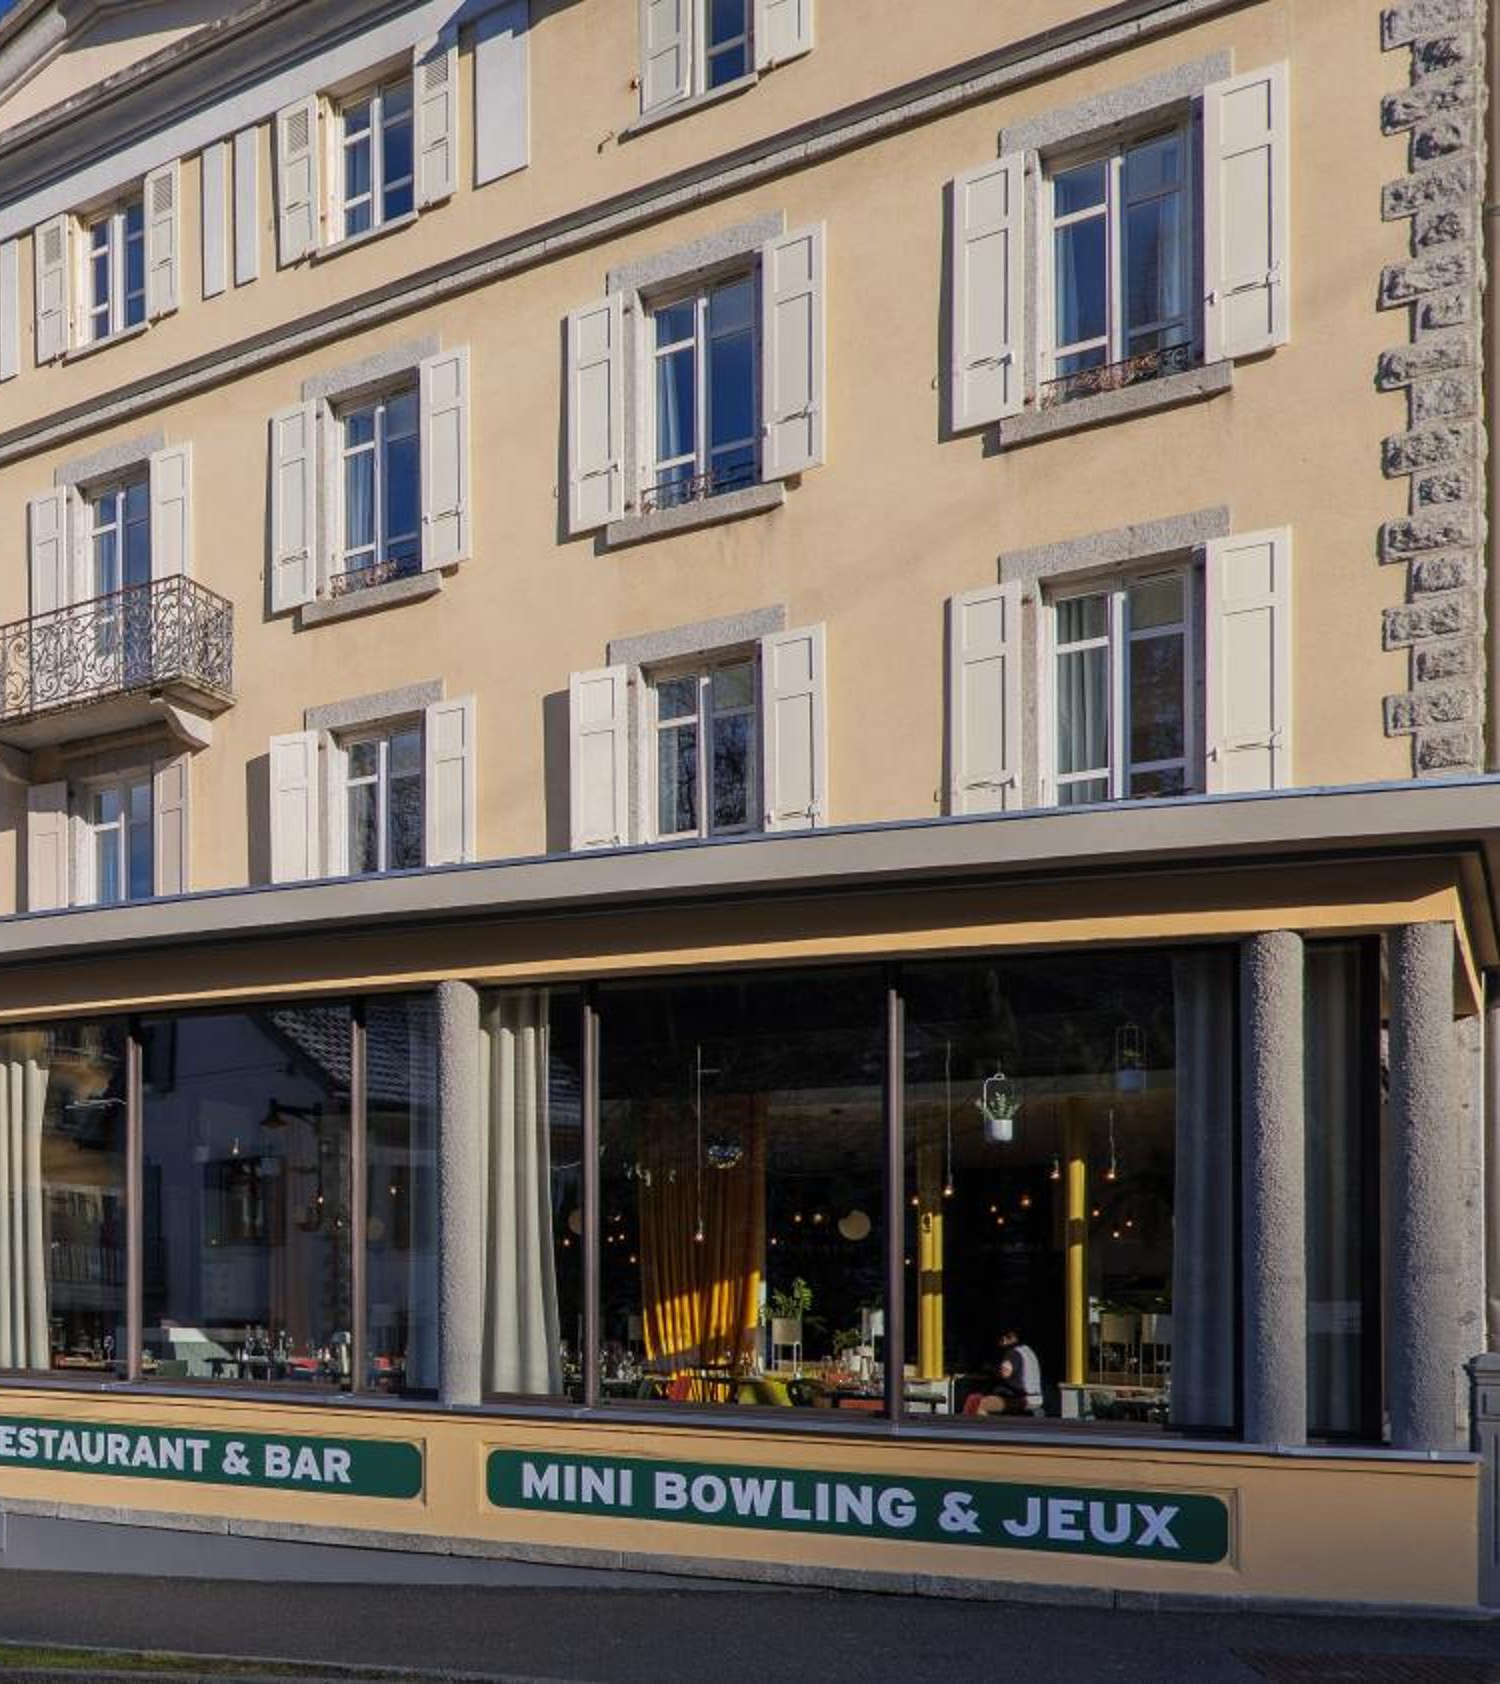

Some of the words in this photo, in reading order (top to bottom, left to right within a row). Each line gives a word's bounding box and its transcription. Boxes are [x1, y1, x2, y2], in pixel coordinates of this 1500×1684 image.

[221, 1441, 251, 1476] &
[264, 1443, 352, 1484] BAR
[521, 1462, 633, 1507] MINI
[655, 1471, 918, 1528] BOWLING
[938, 1491, 982, 1534] &
[1003, 1497, 1181, 1549] JEUX
